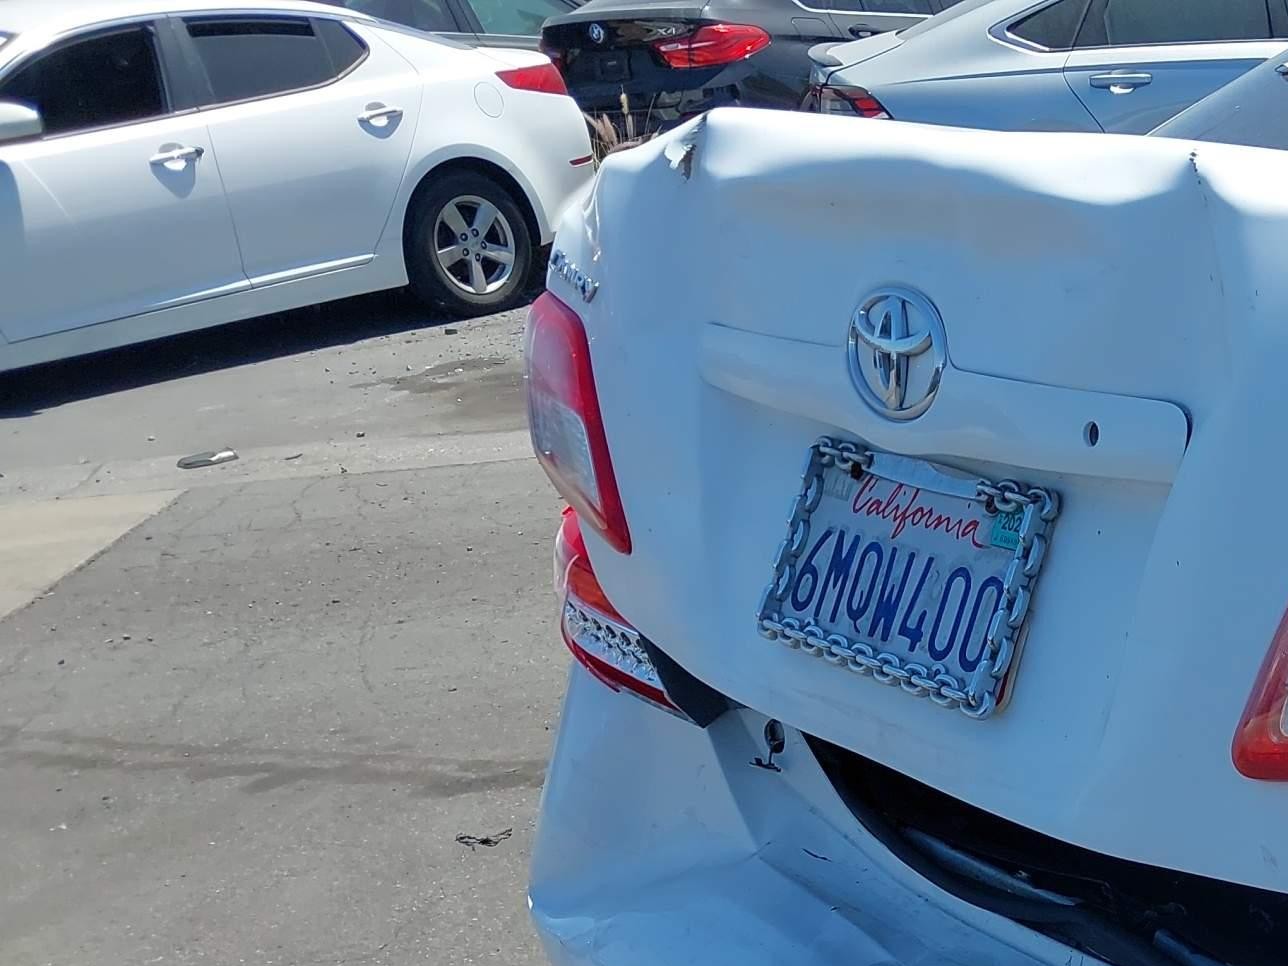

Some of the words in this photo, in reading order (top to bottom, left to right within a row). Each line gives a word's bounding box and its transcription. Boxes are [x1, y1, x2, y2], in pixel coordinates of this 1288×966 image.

[852, 475, 991, 549] California
[1001, 511, 1023, 532] 202
[790, 529, 1005, 673] 6MQW400
